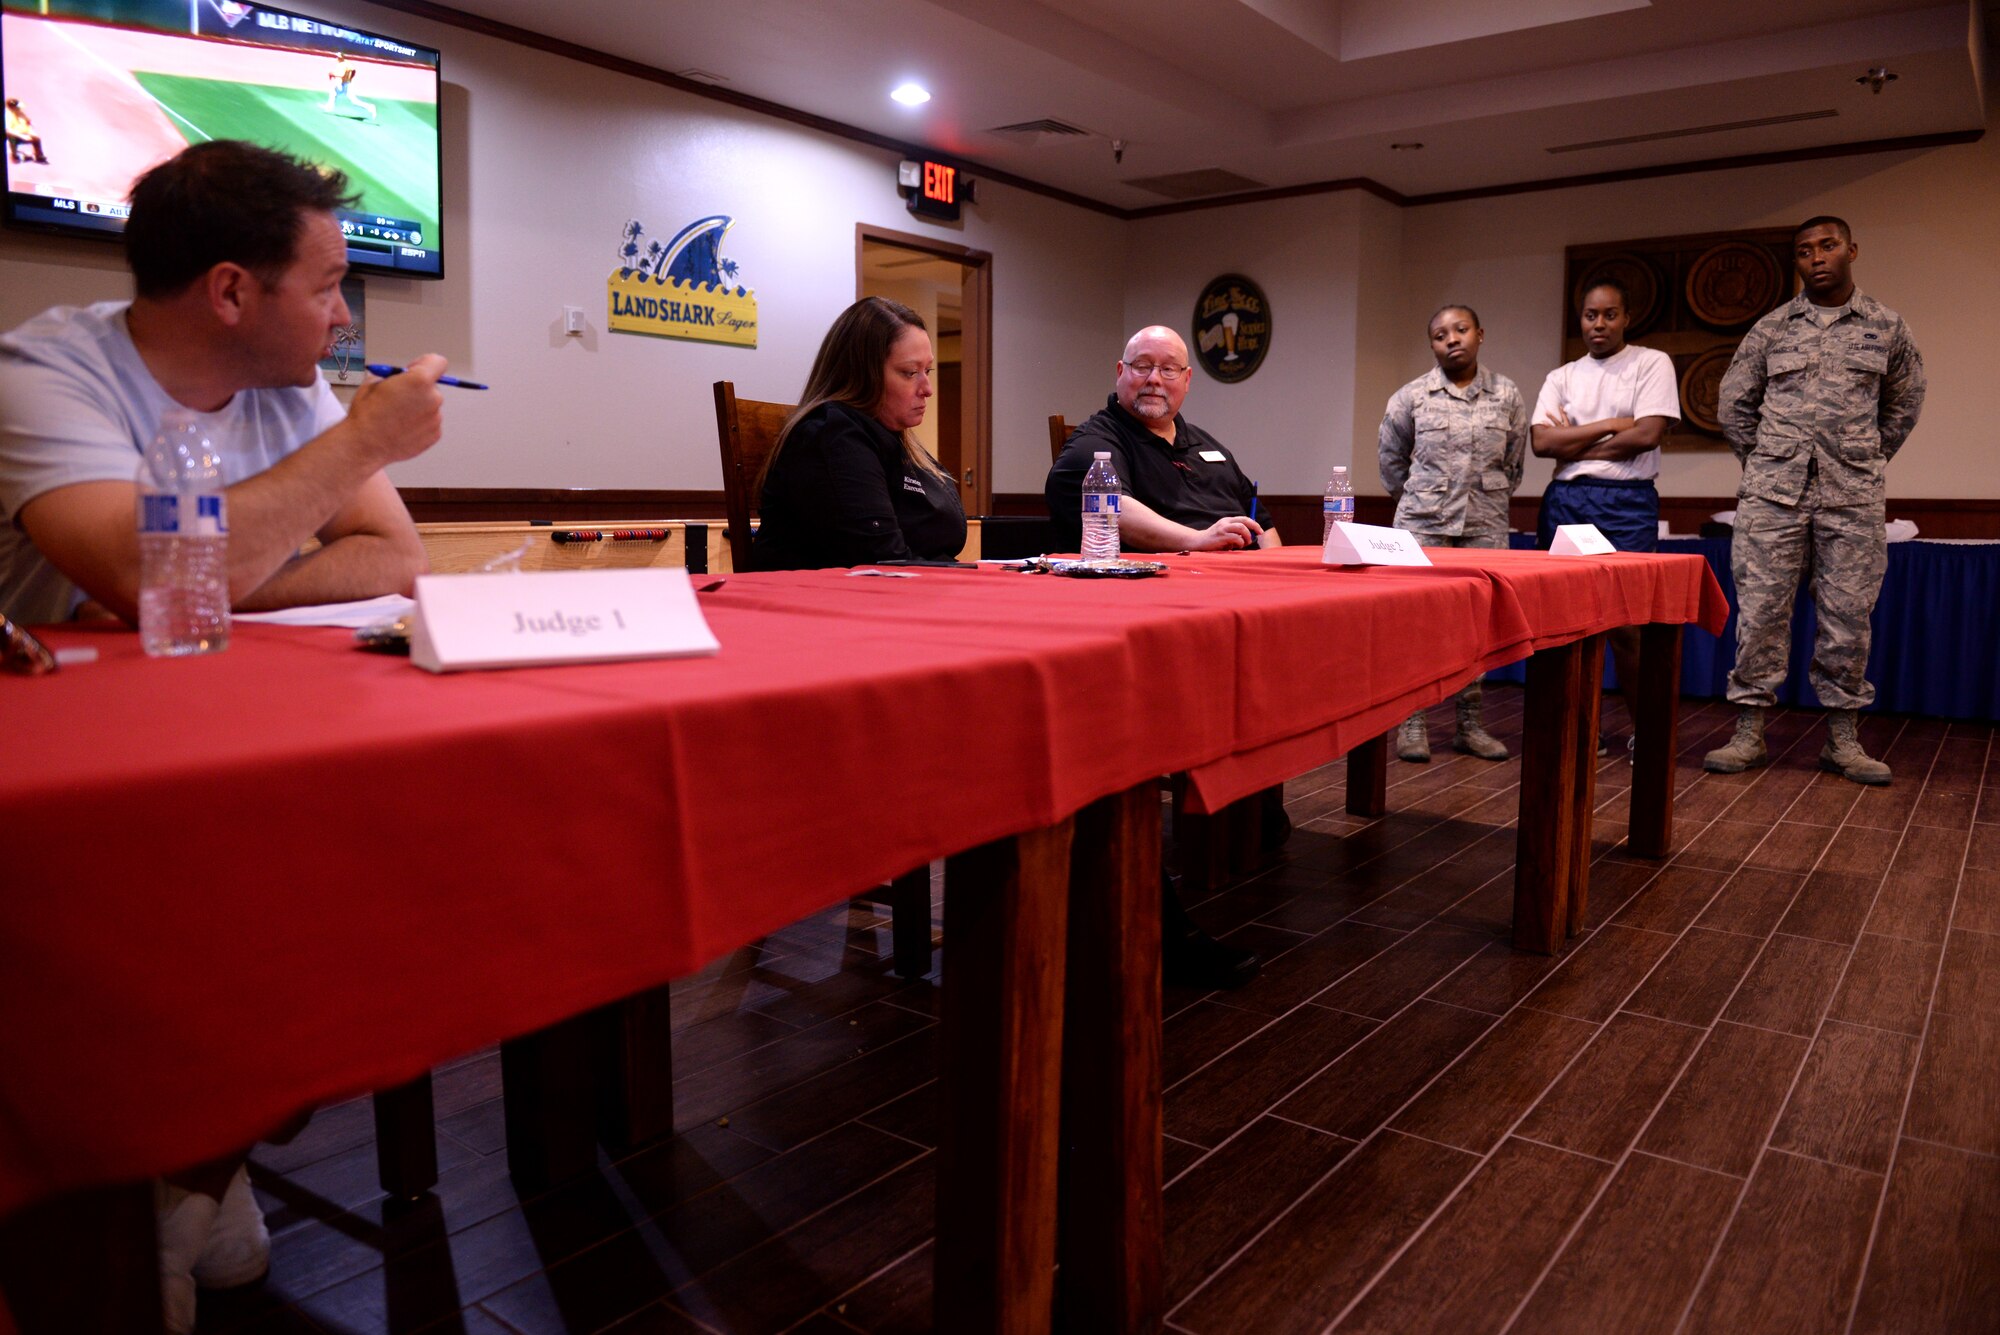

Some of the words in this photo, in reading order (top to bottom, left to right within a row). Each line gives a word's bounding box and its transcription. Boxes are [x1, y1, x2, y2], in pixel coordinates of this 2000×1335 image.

[256, 11, 289, 30] MLB
[374, 39, 416, 56] SPORTSNET
[924, 161, 955, 204] EXIT
[53, 198, 76, 210] MLS
[357, 225, 364, 236] 1
[401, 248, 426, 258] ESPN
[716, 311, 757, 332] Lager
[1368, 539, 1396, 553] Judge
[1394, 541, 1404, 552] 2
[513, 609, 602, 637] Judge
[612, 608, 626, 630] 1
